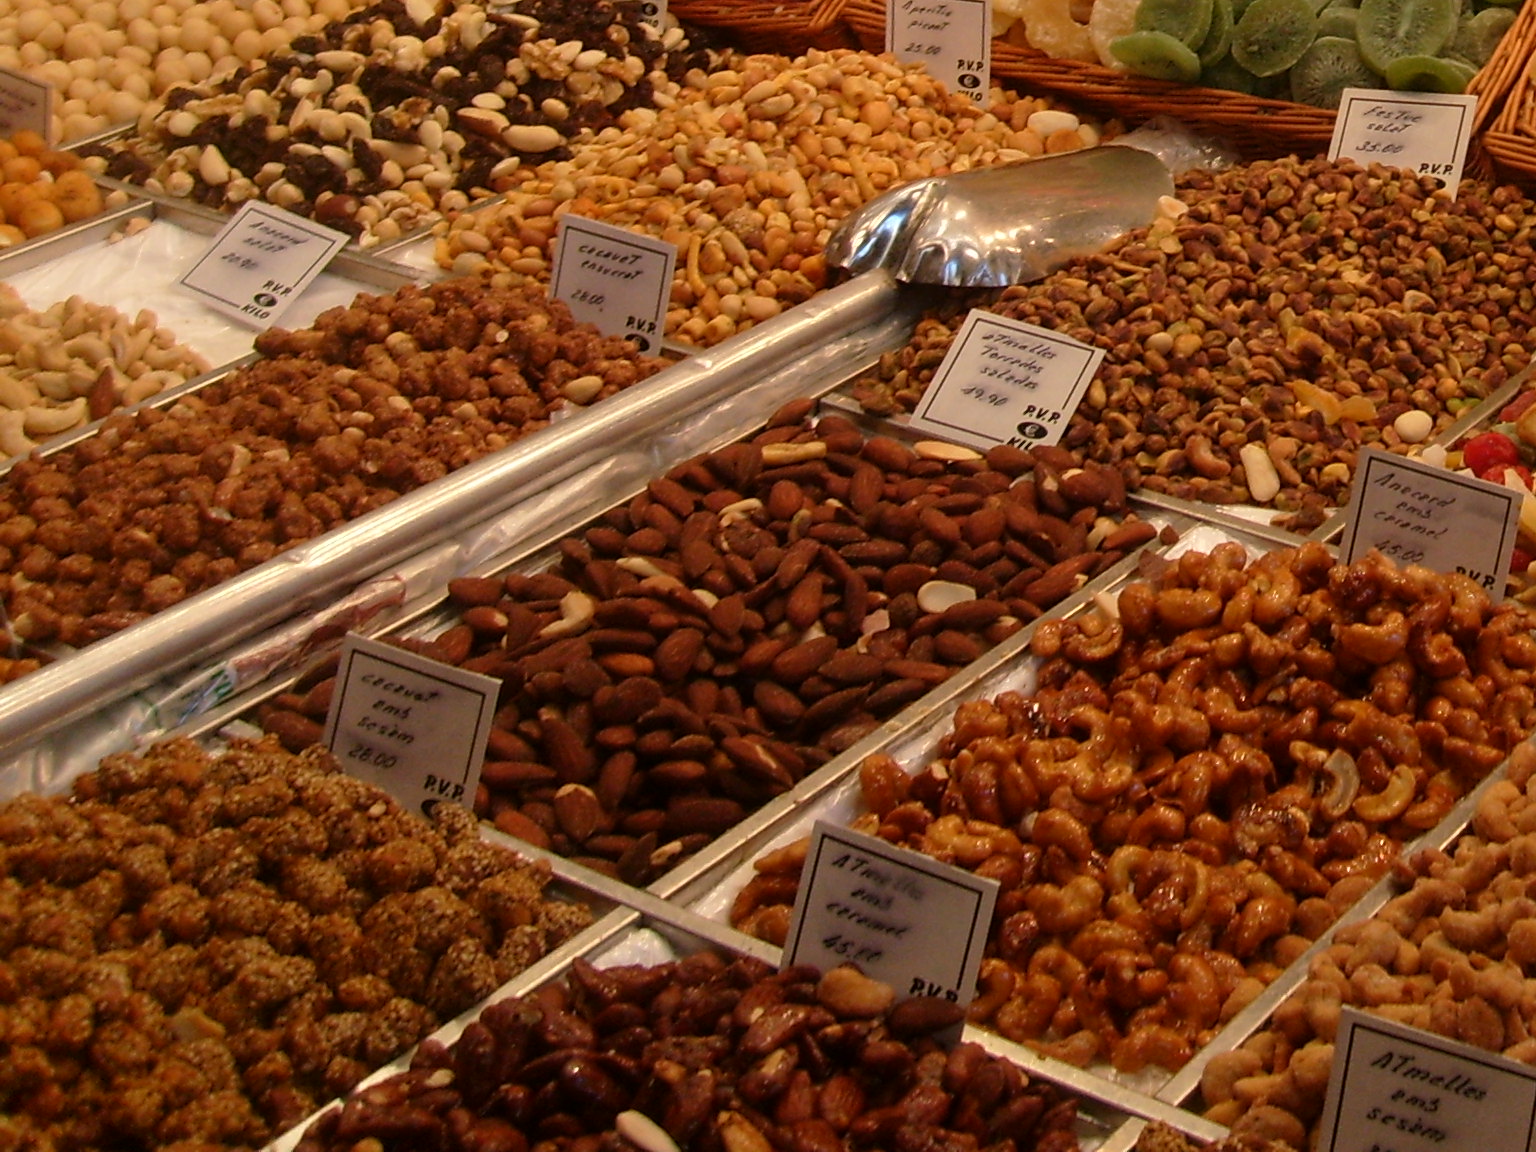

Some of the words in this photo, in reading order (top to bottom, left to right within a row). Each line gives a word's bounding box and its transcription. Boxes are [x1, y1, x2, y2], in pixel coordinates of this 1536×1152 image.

[957, 59, 985, 73] P.V.P.
[1418, 162, 1454, 176] P.V.P.
[263, 279, 293, 298] P.V.P.
[240, 304, 271, 320] KILO
[625, 314, 657, 335] P.V.P.
[1023, 404, 1061, 425] P.V.P.
[1006, 436, 1033, 452] KIL
[424, 774, 464, 801] P.V.P.
